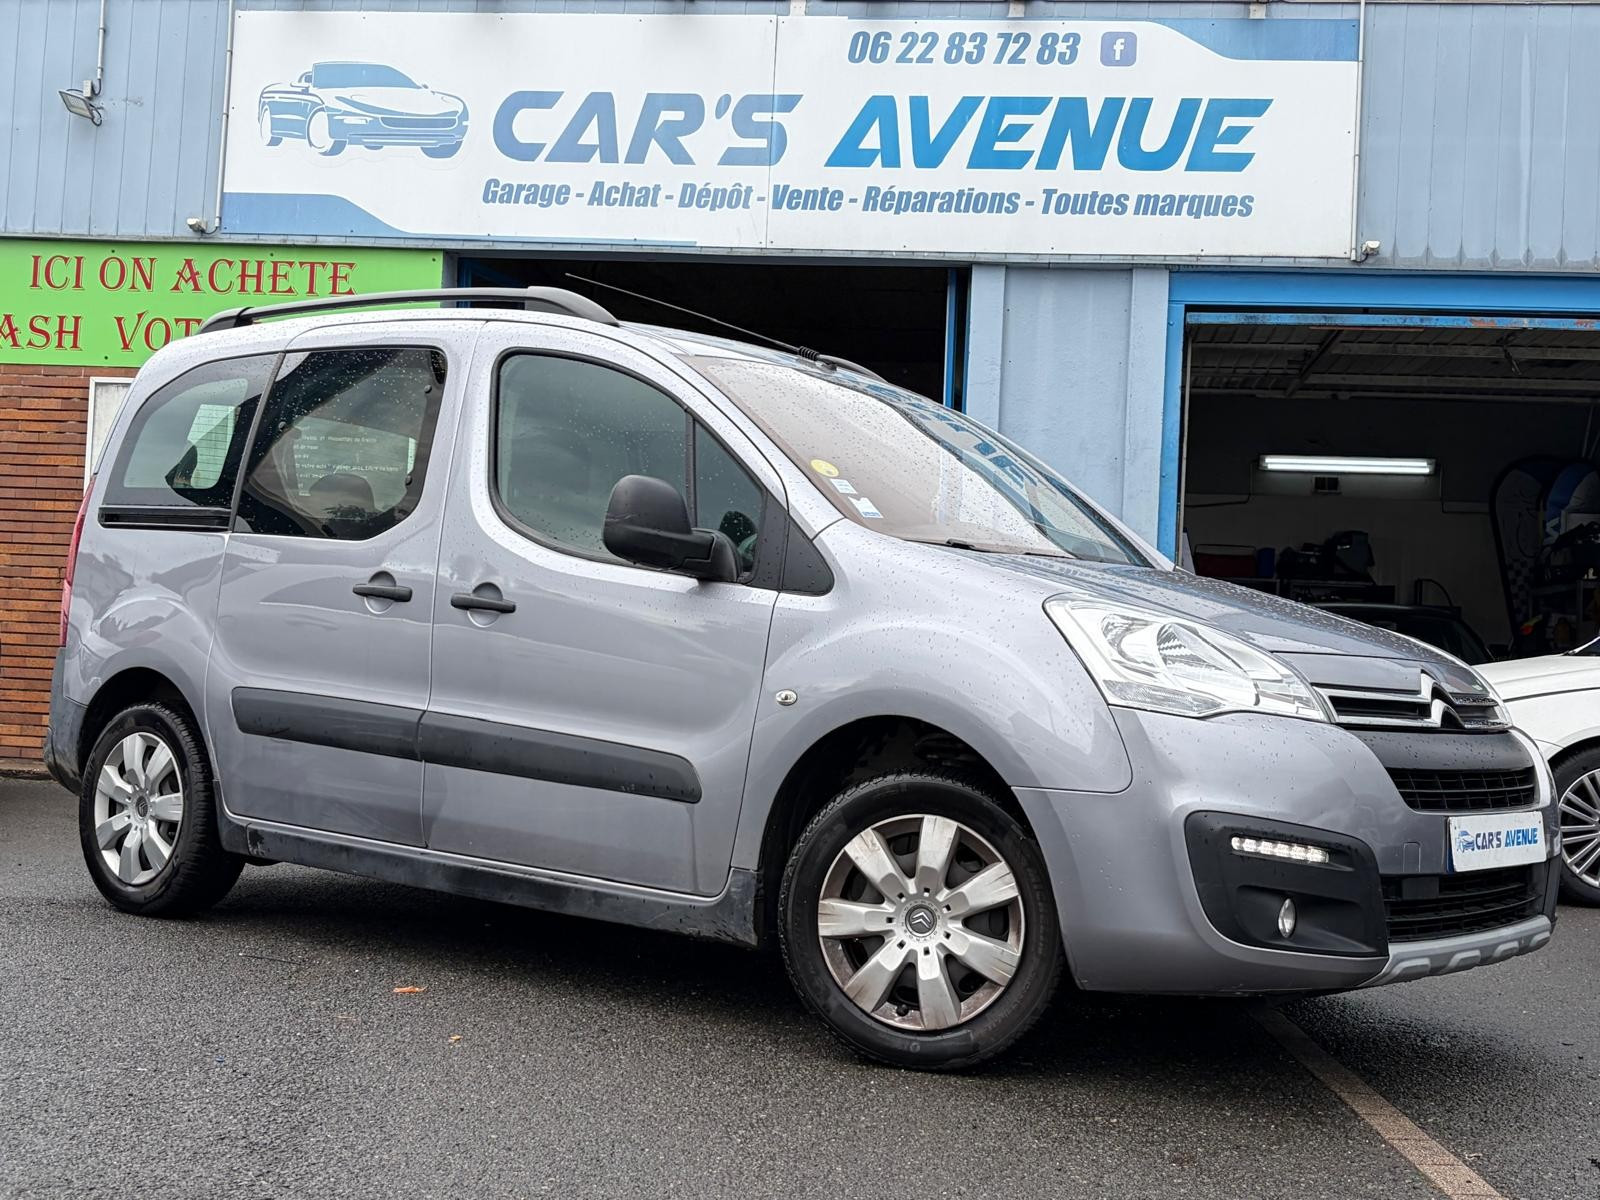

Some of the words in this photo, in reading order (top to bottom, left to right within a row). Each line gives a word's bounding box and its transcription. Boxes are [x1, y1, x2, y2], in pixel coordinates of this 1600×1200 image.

[848, 31, 892, 64] 06
[896, 31, 939, 64] 22
[943, 32, 988, 65] 83
[993, 32, 1031, 65] 72
[1036, 32, 1081, 66] 83
[492, 90, 804, 166] CAR'S
[824, 94, 1274, 172] AVENUE
[482, 178, 570, 208] Garage
[587, 180, 662, 208] Achat
[678, 181, 754, 211] Dépôt
[771, 184, 845, 211] Vente
[862, 185, 1021, 217] Réparations
[1041, 188, 1129, 217] Toutes
[1133, 191, 1255, 219] marques
[30, 255, 85, 291] ICI
[99, 256, 157, 292] ON
[170, 258, 357, 296] ACHETE
[1475, 831, 1502, 850] CAR'S
[1504, 827, 1538, 848] AVENUE
